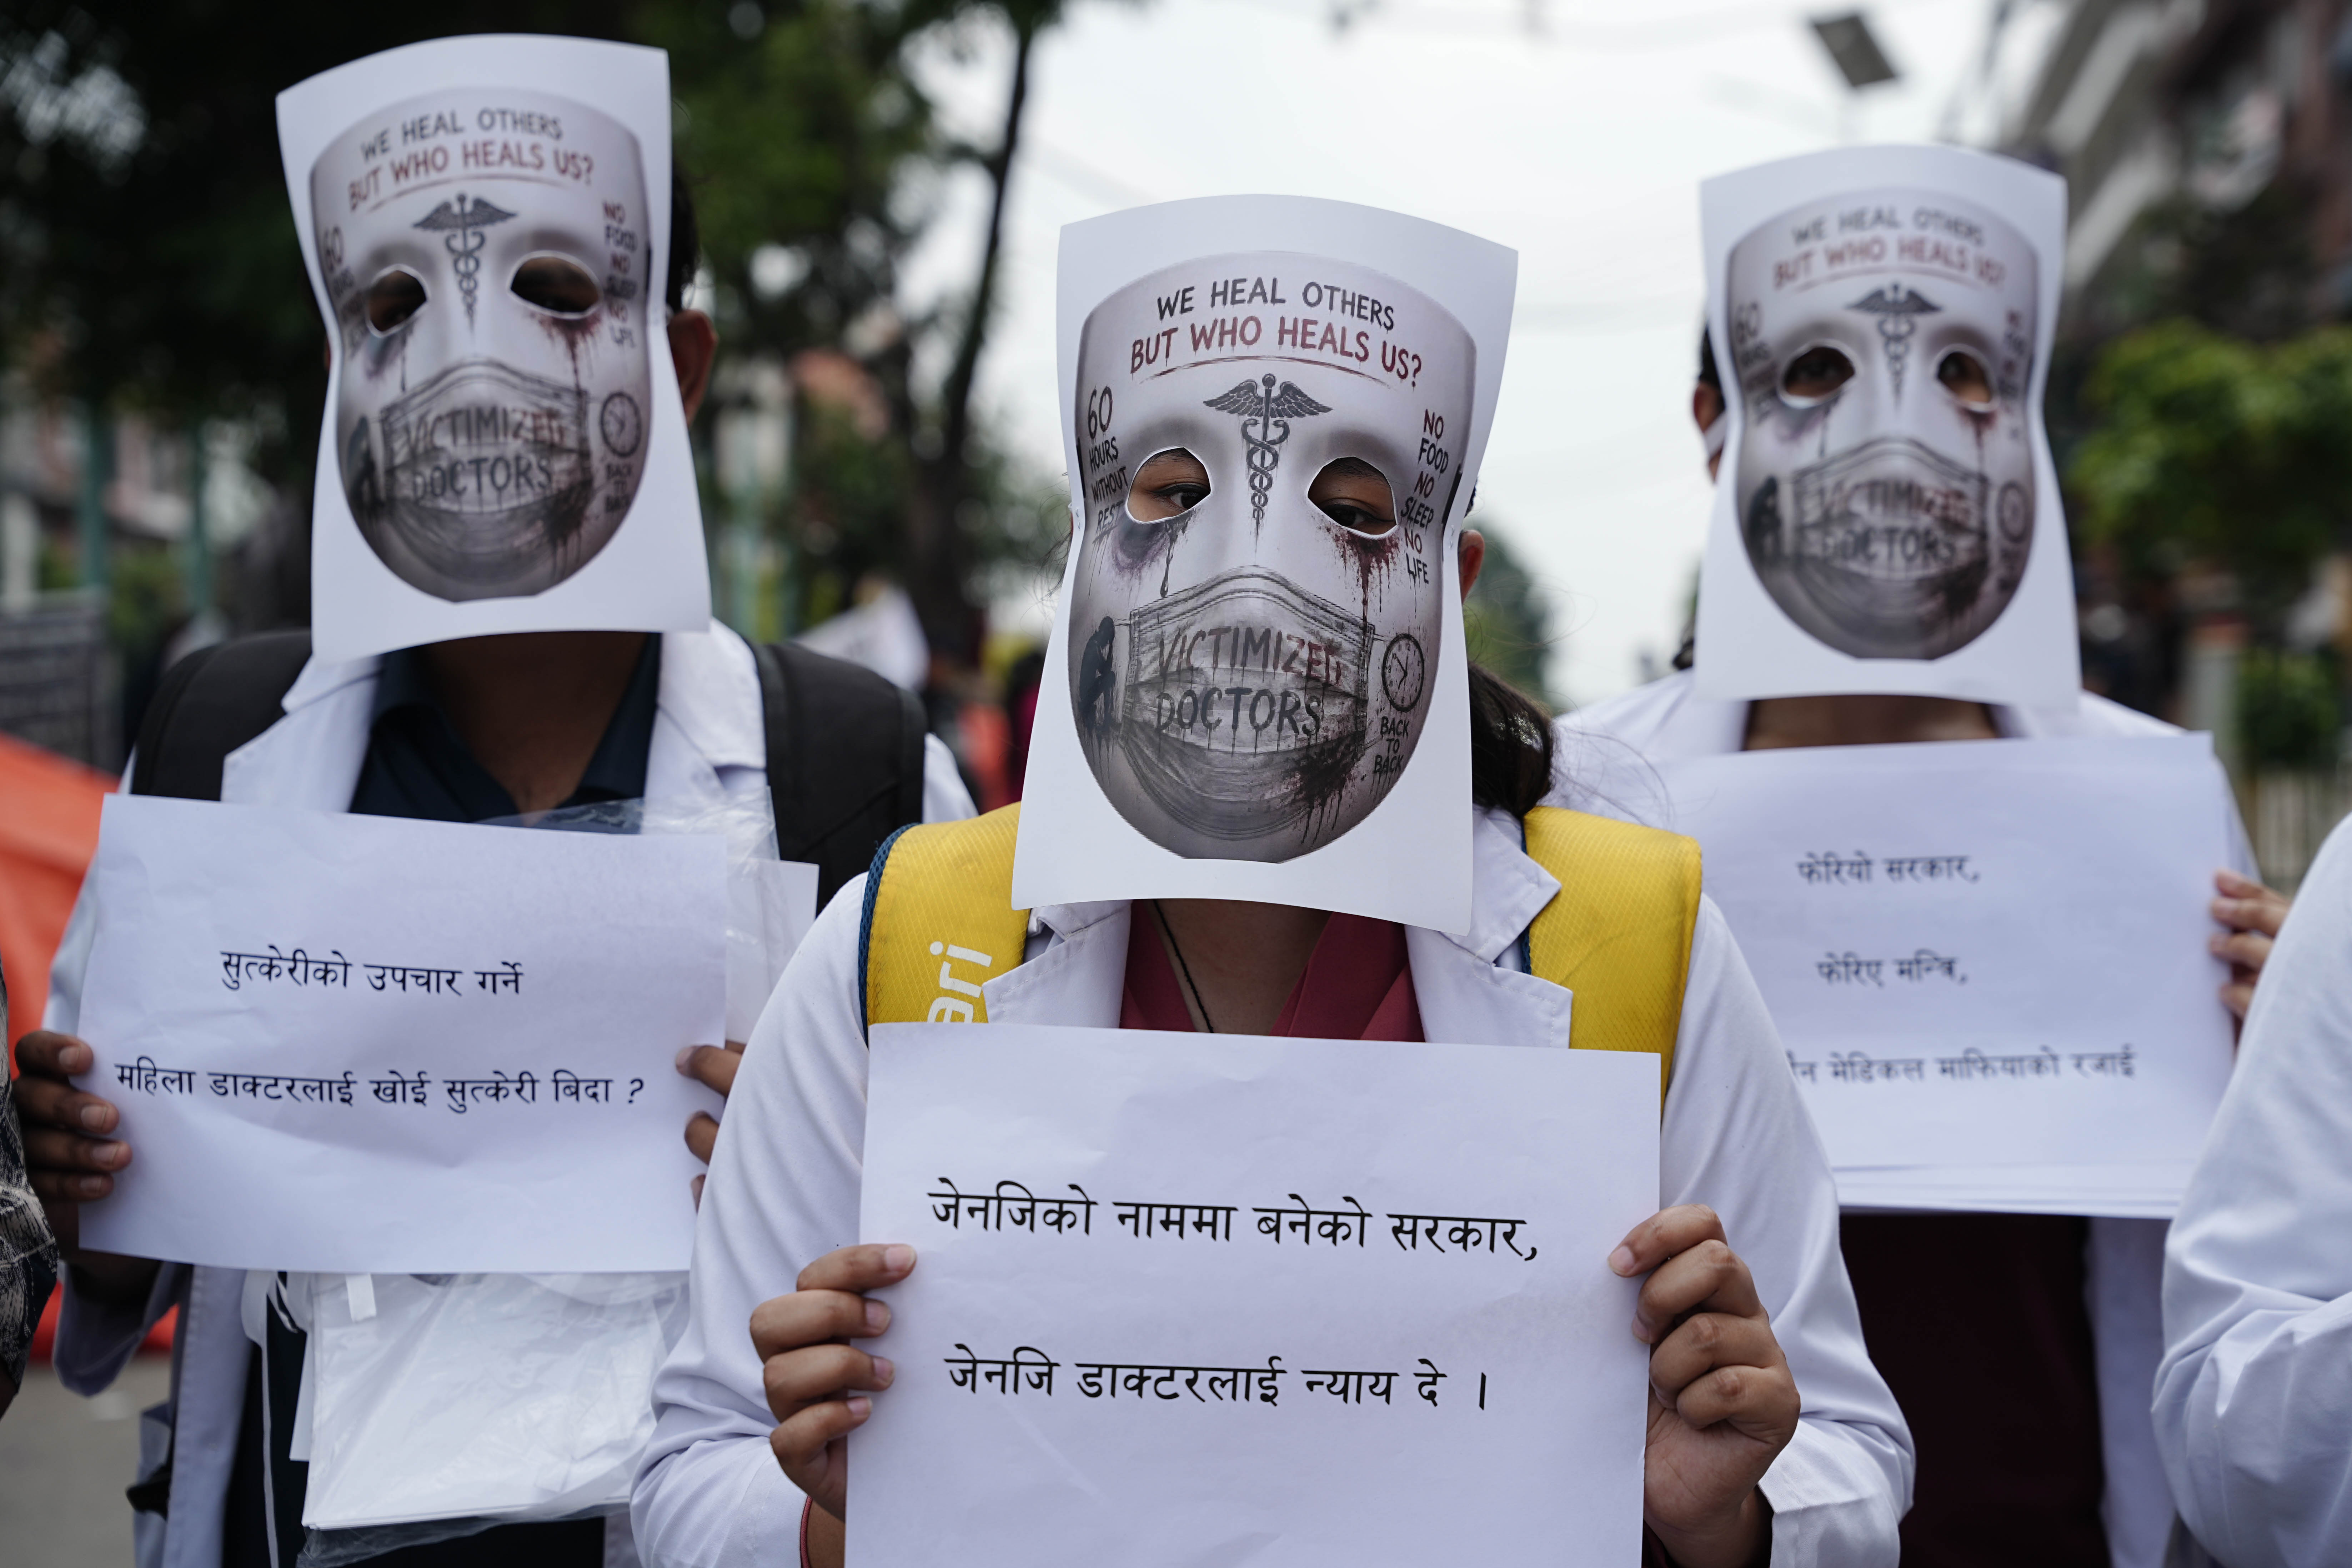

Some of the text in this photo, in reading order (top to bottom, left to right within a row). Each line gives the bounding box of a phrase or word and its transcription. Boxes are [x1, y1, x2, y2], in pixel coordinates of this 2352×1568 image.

[361, 107, 563, 162] WE HEAL OTHERS
[348, 140, 594, 211] BUT WHO HEALS US?
[1792, 218, 1826, 246] WE
[1838, 208, 1901, 233] HEAL
[1774, 251, 1816, 290] BUT
[1825, 238, 1887, 269] WHO
[1899, 236, 1968, 271] HEALS
[1157, 277, 1394, 331] WE HEAL OTHERS
[1130, 315, 1421, 388] BUT WHO HEALS US?
[1088, 385, 1113, 440] 60
[1423, 409, 1444, 439] NO
[1089, 436, 1118, 472] HOURS
[1418, 437, 1449, 474] FOOD
[412, 455, 552, 501] DOCTORS
[1091, 465, 1129, 504] WITHOUT
[1413, 471, 1435, 499] NO
[1096, 501, 1124, 532] REST
[1400, 496, 1434, 531] SLEEP
[1404, 527, 1422, 554] NO
[1406, 553, 1429, 585] LIFE
[1159, 626, 1343, 686] VICTIMIZED
[1156, 687, 1321, 736] DOCTORS
[1380, 716, 1410, 736] BACK
[1373, 754, 1404, 774] BACK
[1386, 738, 1400, 753] TO
[221, 945, 523, 996] सुत्केरीको उपचार गर्ने
[1827, 1051, 1925, 1082] मेडिकल
[1935, 1045, 2060, 1078] माफियाको
[115, 1056, 644, 1114] महिला डाक्टरलाई खोई सुत्केरी बिदा ?
[927, 1177, 1537, 1261] जेनजिको नाममा बनेको सरकार,
[943, 1343, 1061, 1396] जेनजि
[1074, 1356, 1288, 1407] डाक्टरलाई
[1300, 1370, 1400, 1405] न्याय
[1413, 1358, 1448, 1407] दे
